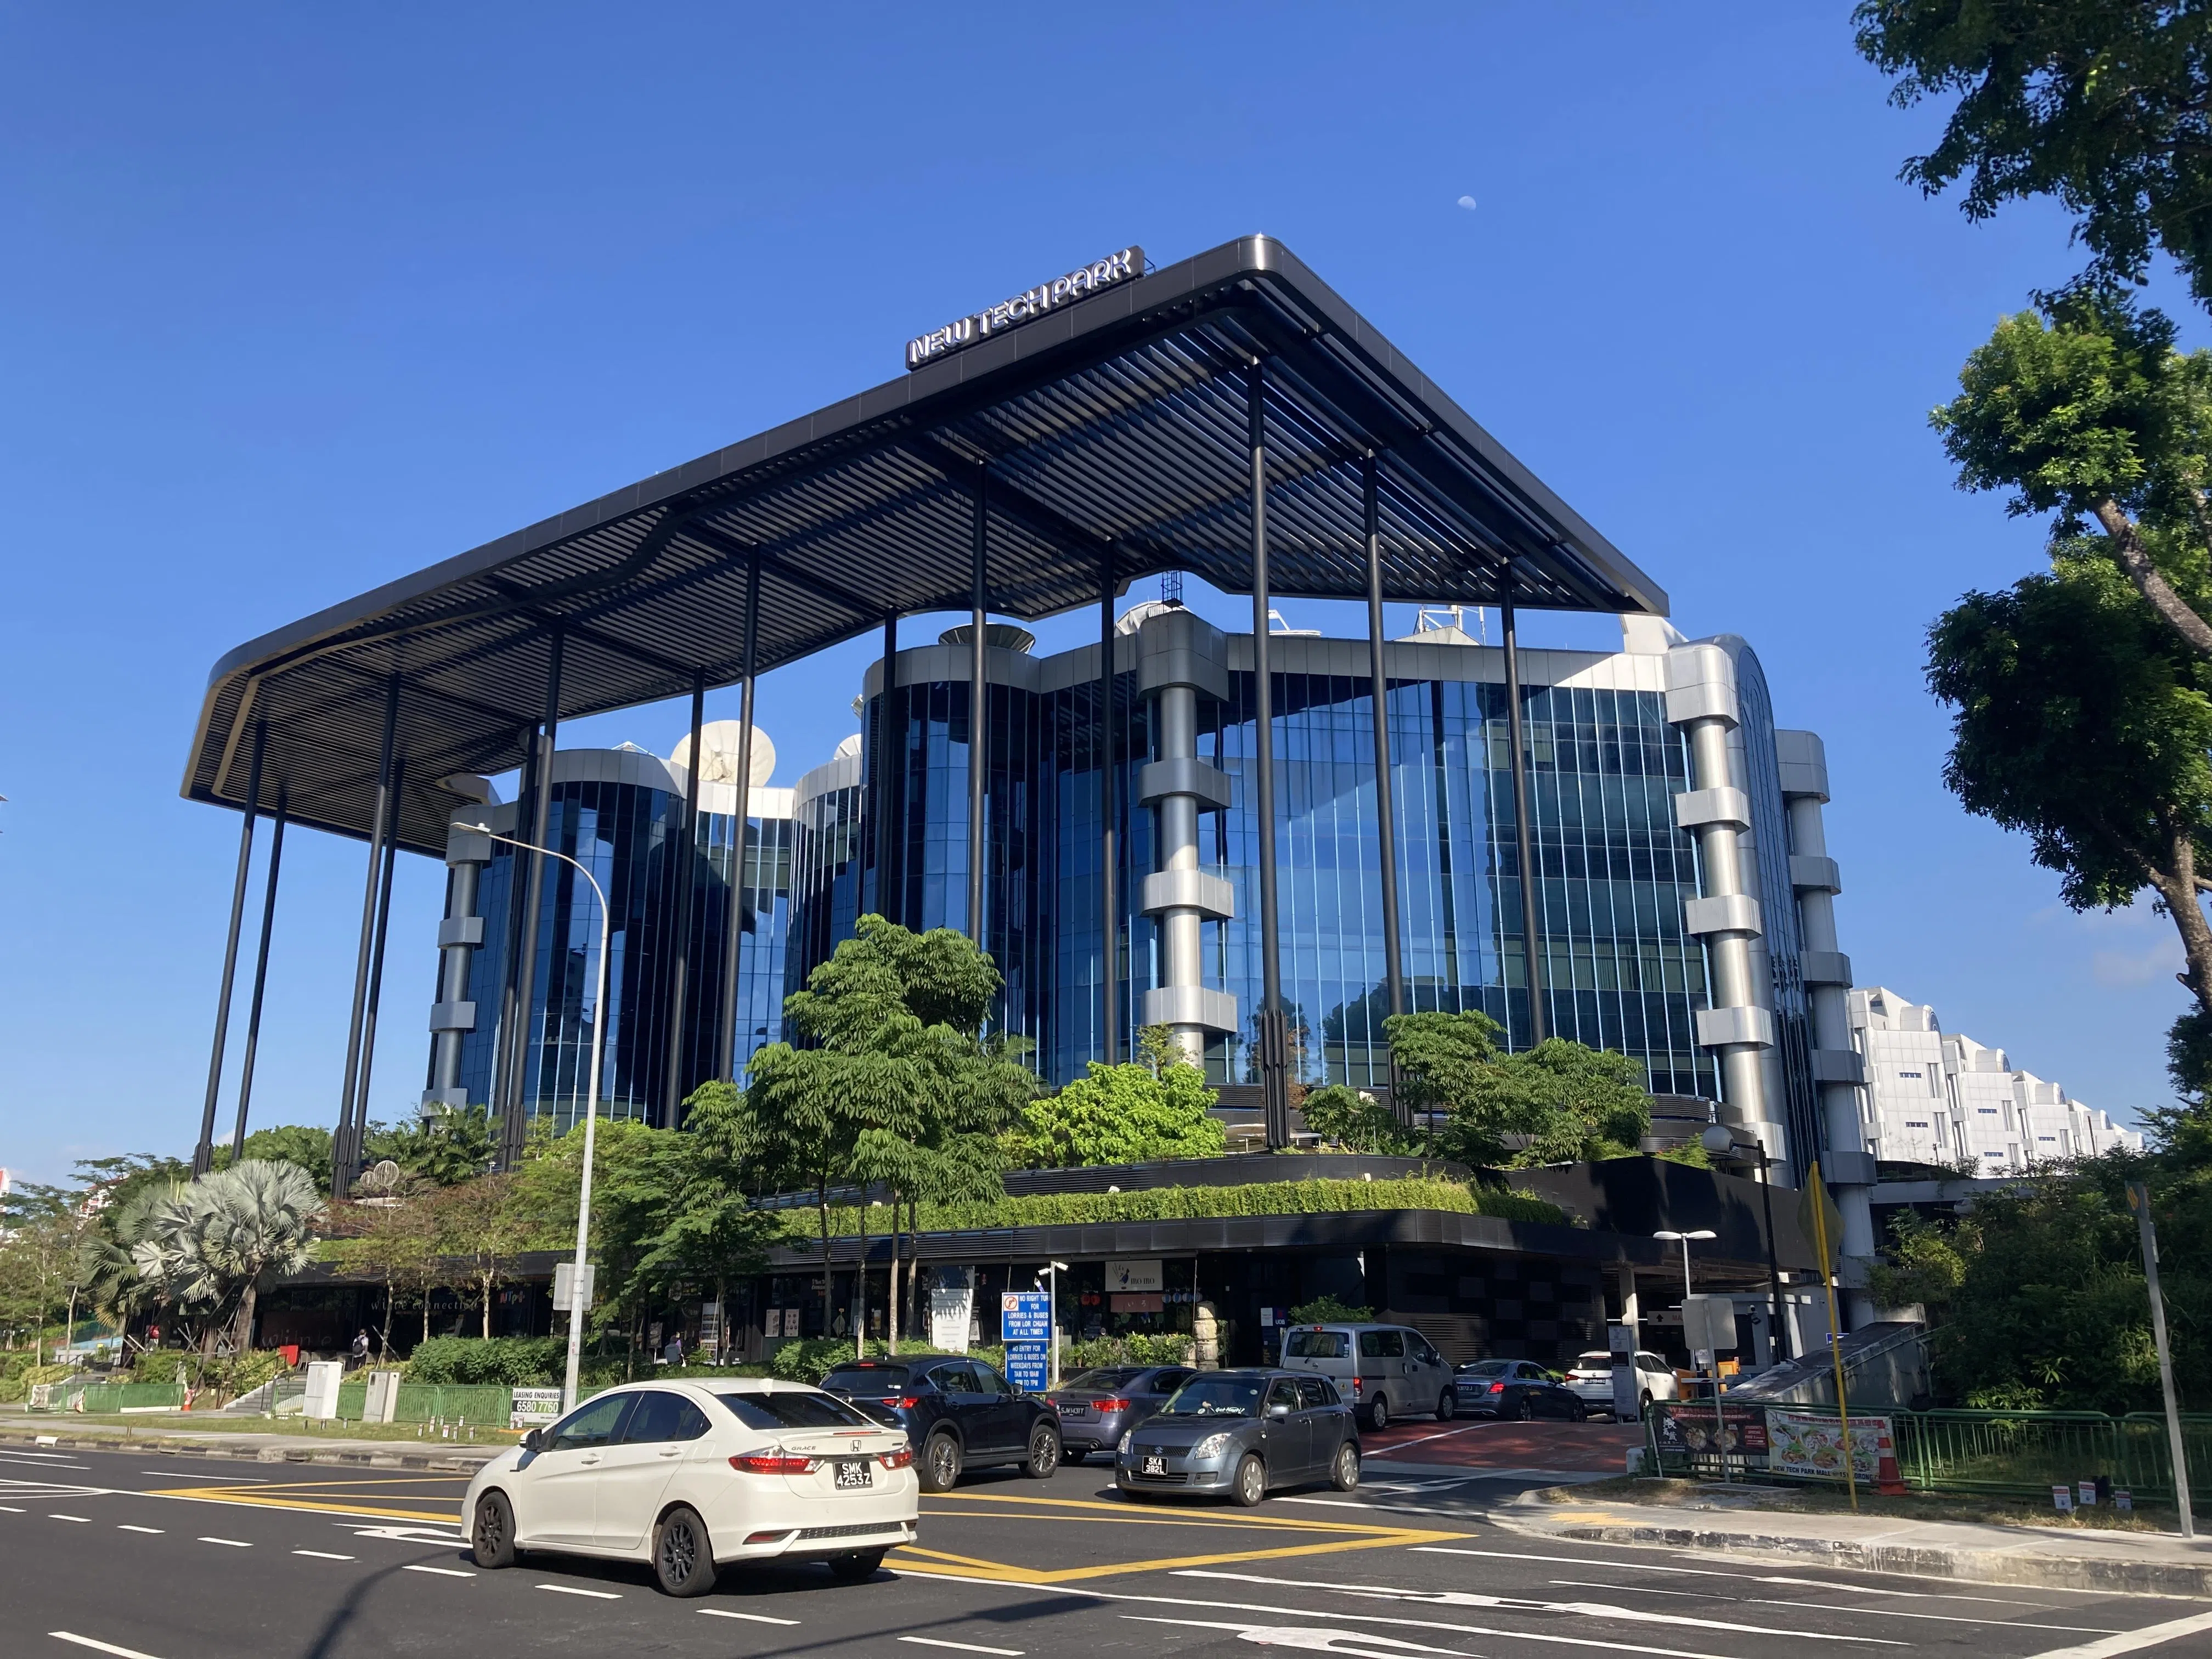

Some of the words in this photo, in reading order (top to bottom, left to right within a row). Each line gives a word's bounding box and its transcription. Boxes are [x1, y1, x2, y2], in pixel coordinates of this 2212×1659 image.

[909, 318, 970, 363] NEW
[973, 285, 1047, 335] TECH
[1052, 249, 1132, 303] PARK
[517, 1401, 537, 1412] 6580
[538, 1401, 558, 1413] 7760
[1148, 1457, 1162, 1466] SKA
[842, 1462, 862, 1474] SMK
[1146, 1465, 1164, 1474] 382L
[837, 1472, 871, 1486] 4253Z
